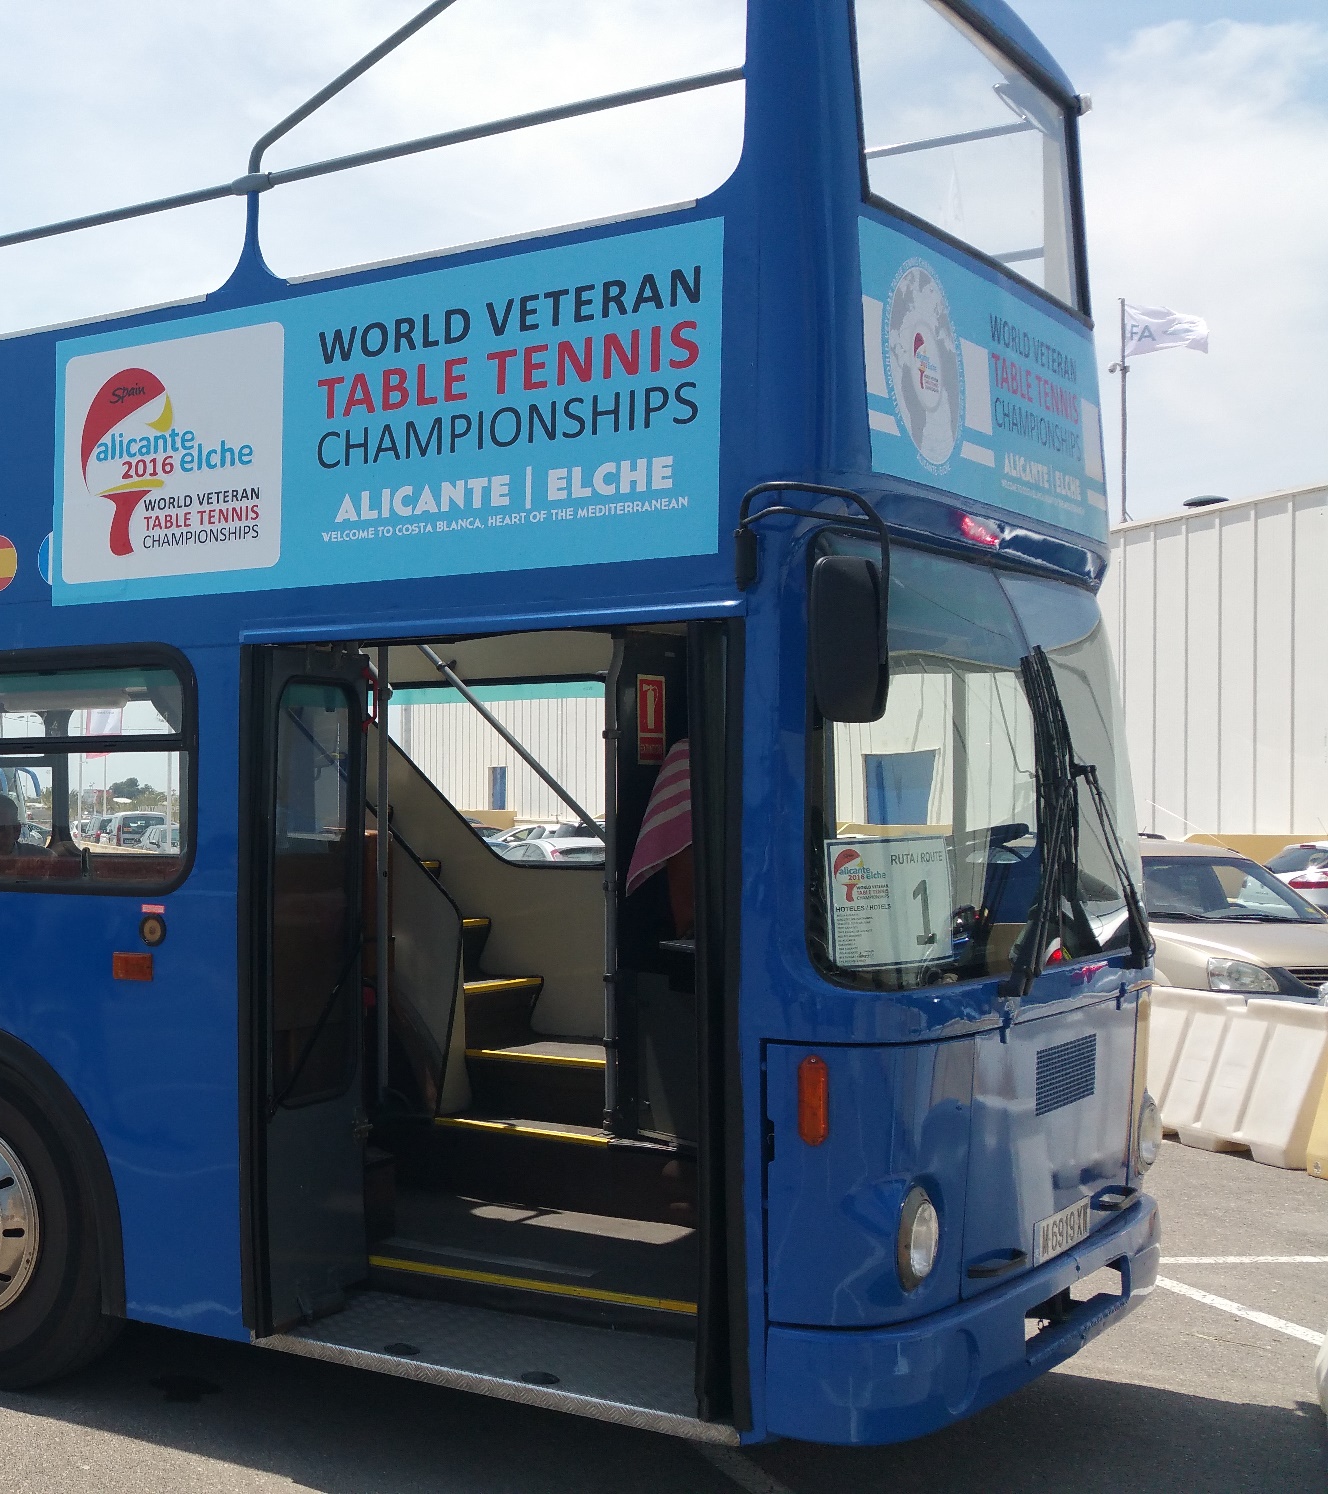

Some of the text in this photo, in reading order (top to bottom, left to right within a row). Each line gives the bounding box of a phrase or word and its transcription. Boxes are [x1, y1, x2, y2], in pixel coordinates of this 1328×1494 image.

[319, 265, 701, 365] WORLD VETERAN
[989, 313, 1076, 384] WORLD VETERAN
[318, 320, 700, 420] TABLE TENNIS
[109, 383, 146, 404] Spain
[992, 352, 1033, 403] TABLE
[1035, 374, 1079, 425] TENNIS
[317, 381, 699, 469] CHAMPIONSHIPS
[994, 397, 1081, 461] CHAMPIONSHIPS
[95, 428, 195, 462] alicante
[179, 439, 254, 473] elche
[121, 455, 174, 480] 2016
[1004, 452, 1049, 489] ALICANTE
[144, 487, 260, 512] WORLD VETERAN
[334, 475, 510, 523] ALICANTE
[548, 456, 673, 501] ELCHE
[144, 504, 260, 531] TABLE TENNIS
[321, 496, 688, 543] WELCOME TO COSTA BLANCA, HEART OF THE MEDITERRANEAN
[143, 524, 259, 549] CHAMPIONSHIPS
[838, 866, 871, 876] alicante
[890, 853, 915, 866] RUTA
[920, 851, 943, 863] ROUTE
[835, 905, 865, 913] HOTELES
[912, 879, 937, 946] 1
